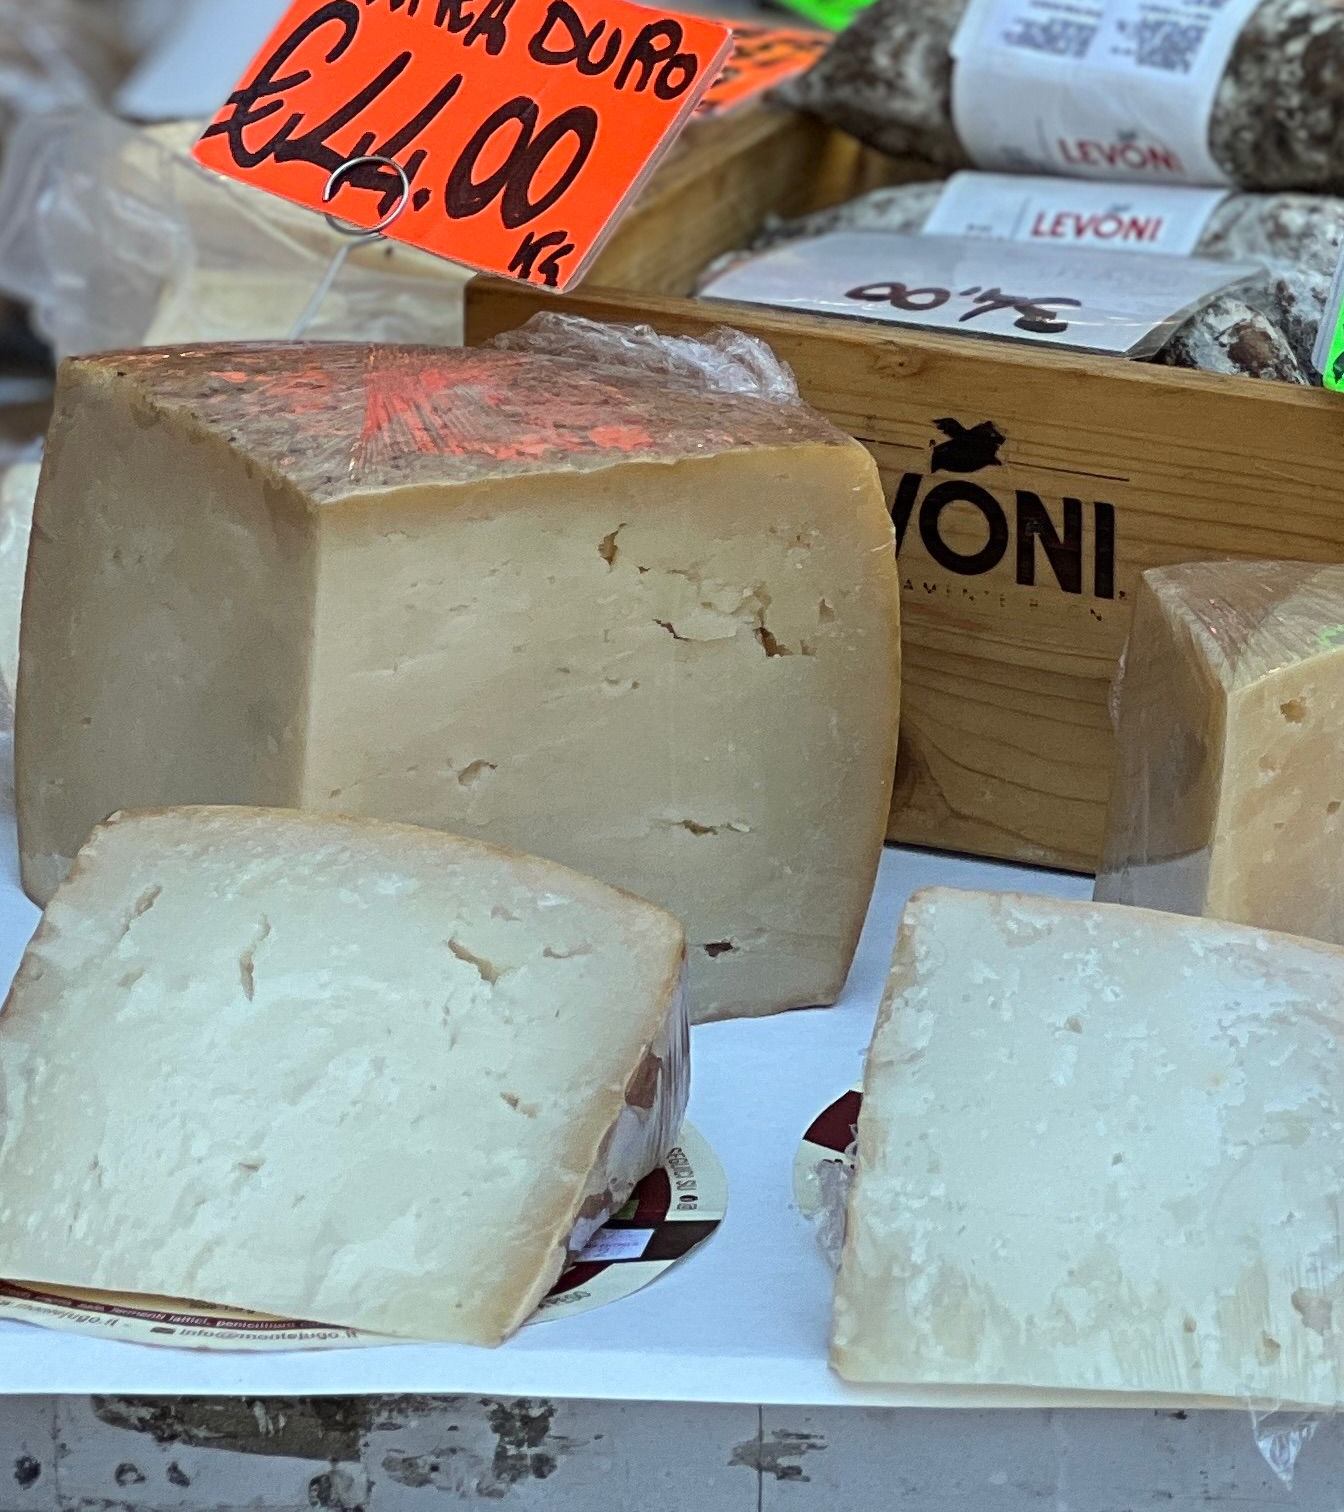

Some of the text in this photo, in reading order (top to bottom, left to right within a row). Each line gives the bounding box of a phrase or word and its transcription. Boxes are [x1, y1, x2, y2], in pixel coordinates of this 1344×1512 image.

[528, 0, 698, 100] DURO
[1030, 209, 1164, 243] LEVONI
[890, 472, 1115, 600] VONI
